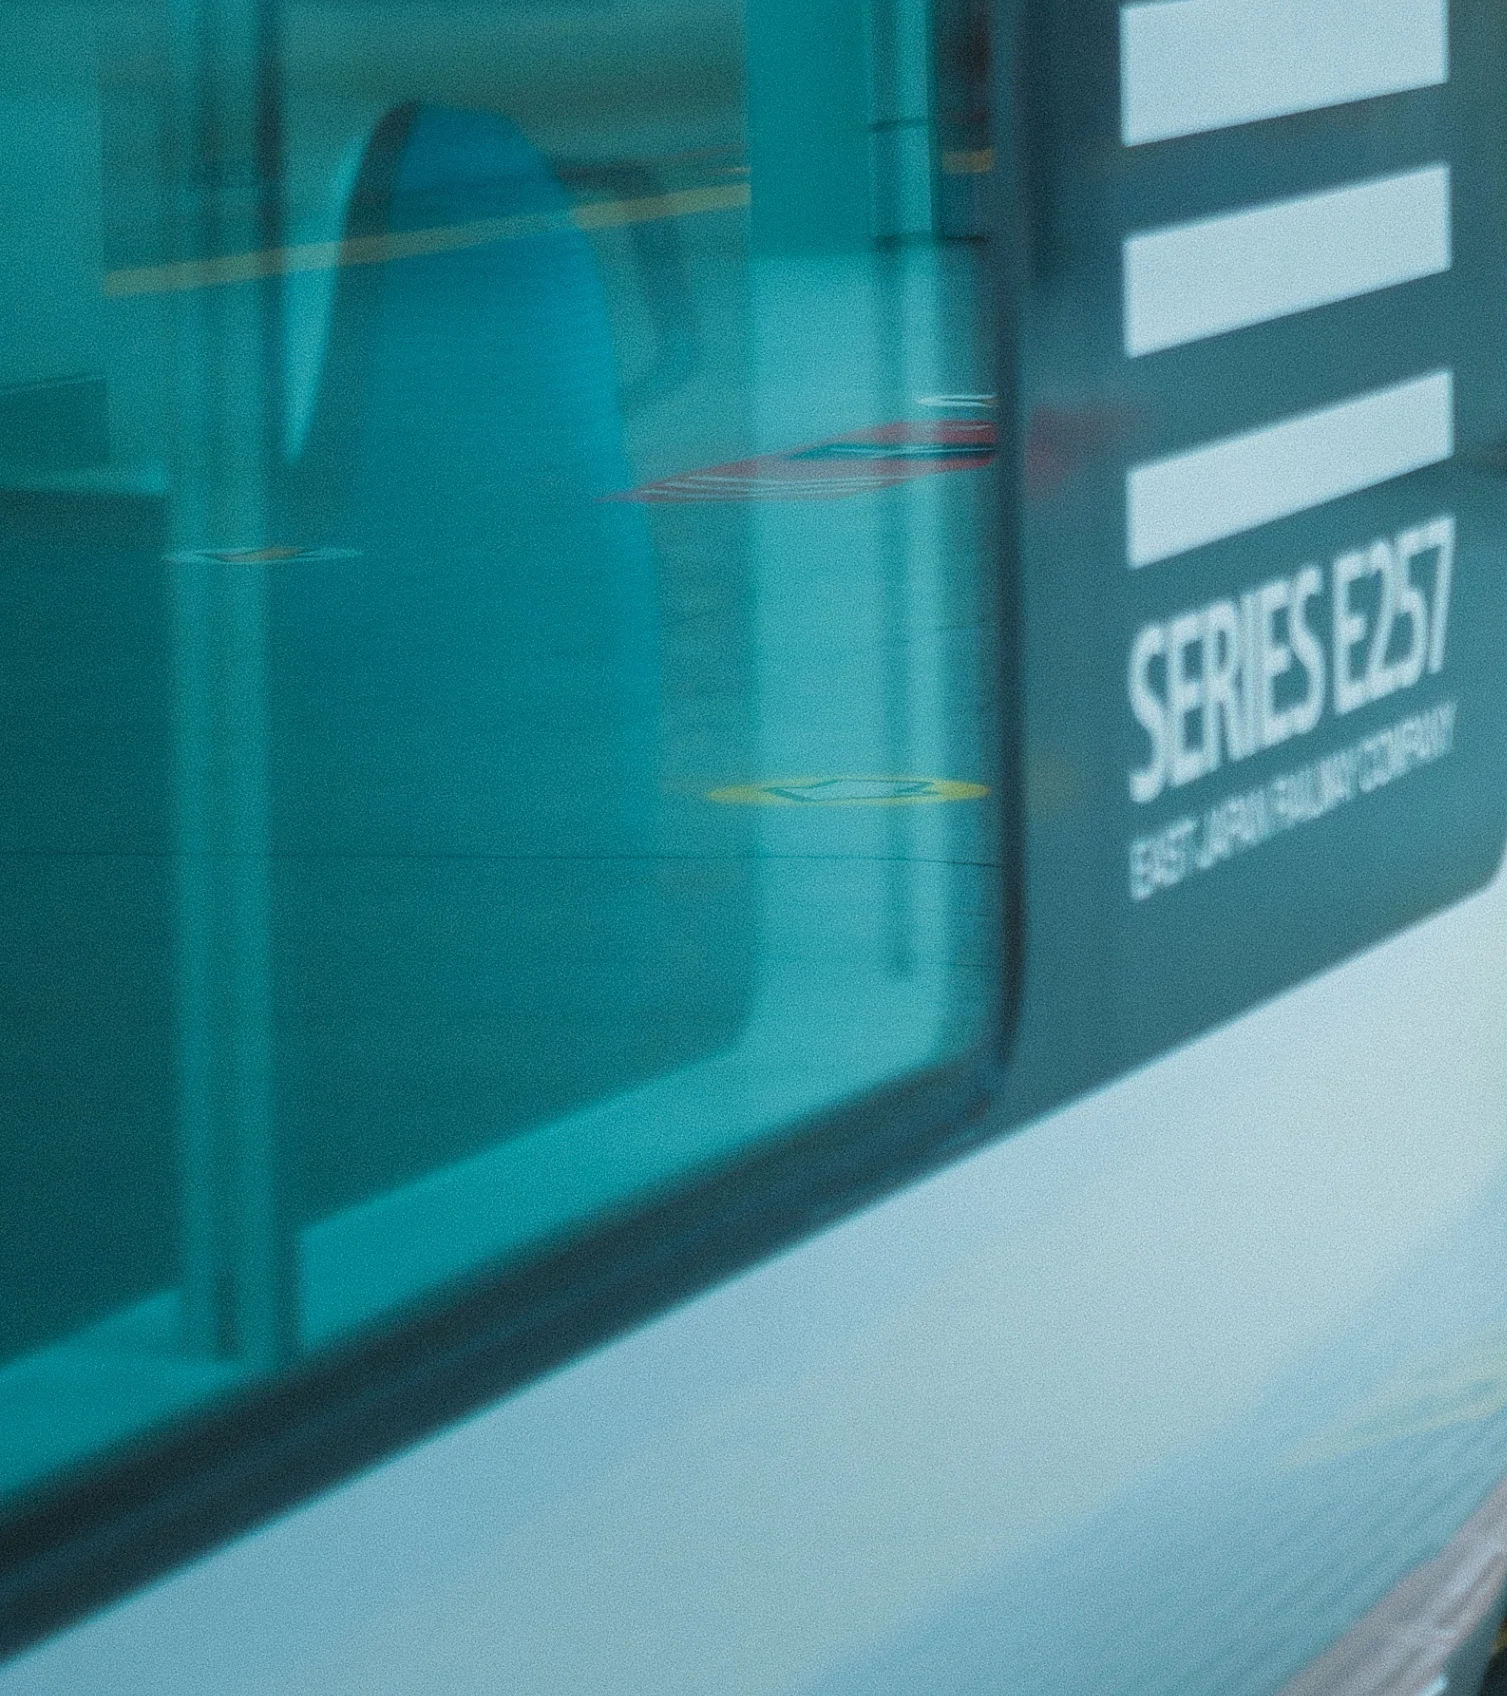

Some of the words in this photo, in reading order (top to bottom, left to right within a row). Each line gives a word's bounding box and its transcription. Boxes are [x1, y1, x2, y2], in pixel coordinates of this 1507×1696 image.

[1127, 564, 1326, 803] SERIES
[1331, 513, 1458, 716] E257
[1130, 817, 1198, 902] EAST
[1198, 790, 1268, 870] JAPAN
[1269, 749, 1359, 829] RAILWAY
[1359, 700, 1458, 794] COMPANY
